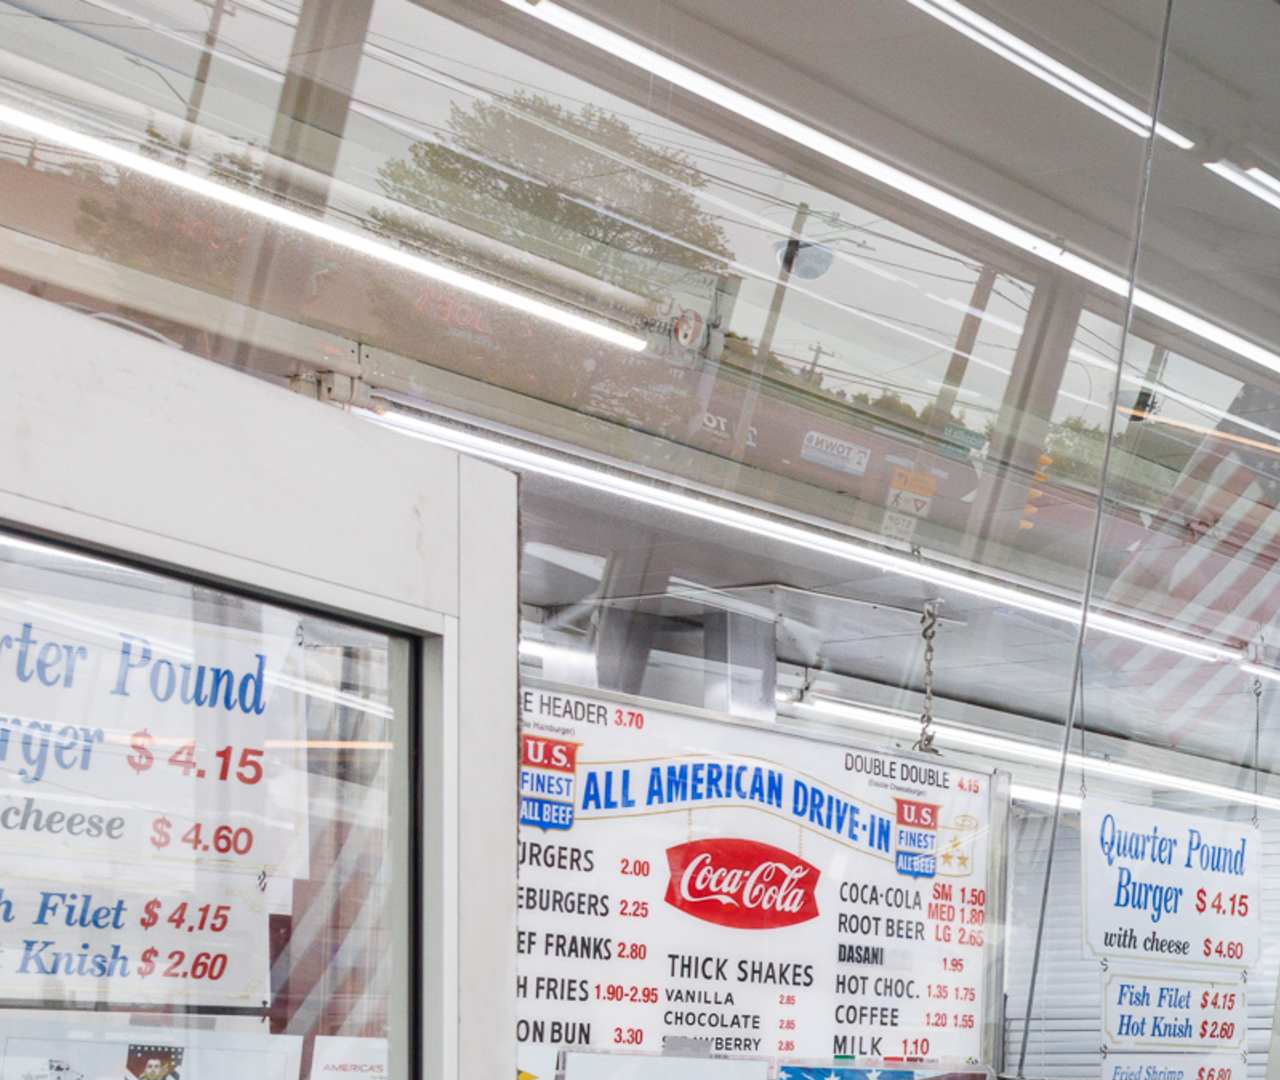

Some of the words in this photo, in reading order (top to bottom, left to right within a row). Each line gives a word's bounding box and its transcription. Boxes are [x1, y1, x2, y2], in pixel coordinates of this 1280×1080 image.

[110, 633, 267, 715] Pound
[540, 694, 608, 726] HEADER
[614, 708, 644, 730] 3.70
[526, 740, 571, 768] U.S.
[521, 771, 573, 797] FINEST
[845, 752, 897, 779] DOUBLE
[900, 763, 950, 789] DOUBLE
[582, 769, 636, 810] ALL
[646, 763, 783, 808] AMERICAN
[0, 798, 125, 839] cheese
[520, 800, 540, 821] ALL
[542, 803, 574, 826] BEEF
[902, 804, 936, 827] U.S.
[898, 829, 936, 849] FINEST
[1100, 814, 1178, 866] Quarter
[1184, 829, 1248, 876] Pound
[620, 858, 650, 877] 2.00
[932, 882, 953, 902] SM
[960, 887, 986, 906] 1.50
[1113, 867, 1183, 923] Burger
[33, 890, 127, 931] Filet
[619, 899, 649, 918] 2.25
[928, 903, 955, 922] MED
[959, 908, 985, 926] 1.80
[838, 913, 881, 936] ROOT
[885, 918, 925, 941] BEER
[934, 925, 951, 943] LG
[1103, 927, 1138, 950] with
[1143, 931, 1190, 956] cheese
[17, 938, 130, 979] Knish
[545, 933, 613, 960] FRANKS
[616, 942, 647, 960] 2.80
[838, 944, 884, 966] DASANI
[943, 958, 965, 973] 1.95
[667, 954, 728, 981] THICK
[737, 959, 814, 987] SHAKES
[535, 976, 589, 1001] FRIES
[595, 984, 659, 1003] 1.90-2.95
[665, 988, 735, 1006] VANILLA
[836, 974, 868, 995] HOT
[874, 977, 920, 999] CHOC.
[1117, 983, 1151, 1008] Fish
[1156, 986, 1192, 1010] Filet
[663, 1010, 761, 1029] CHOCOLATE
[835, 1005, 899, 1027] COFFEE
[1117, 1014, 1146, 1037] Hot
[1150, 1016, 1194, 1040] Knish
[516, 1019, 545, 1043] ON
[550, 1021, 591, 1045] BUN
[614, 1027, 644, 1045] 3.30
[833, 1035, 883, 1057] MILK
[902, 1038, 930, 1056] 1.10
